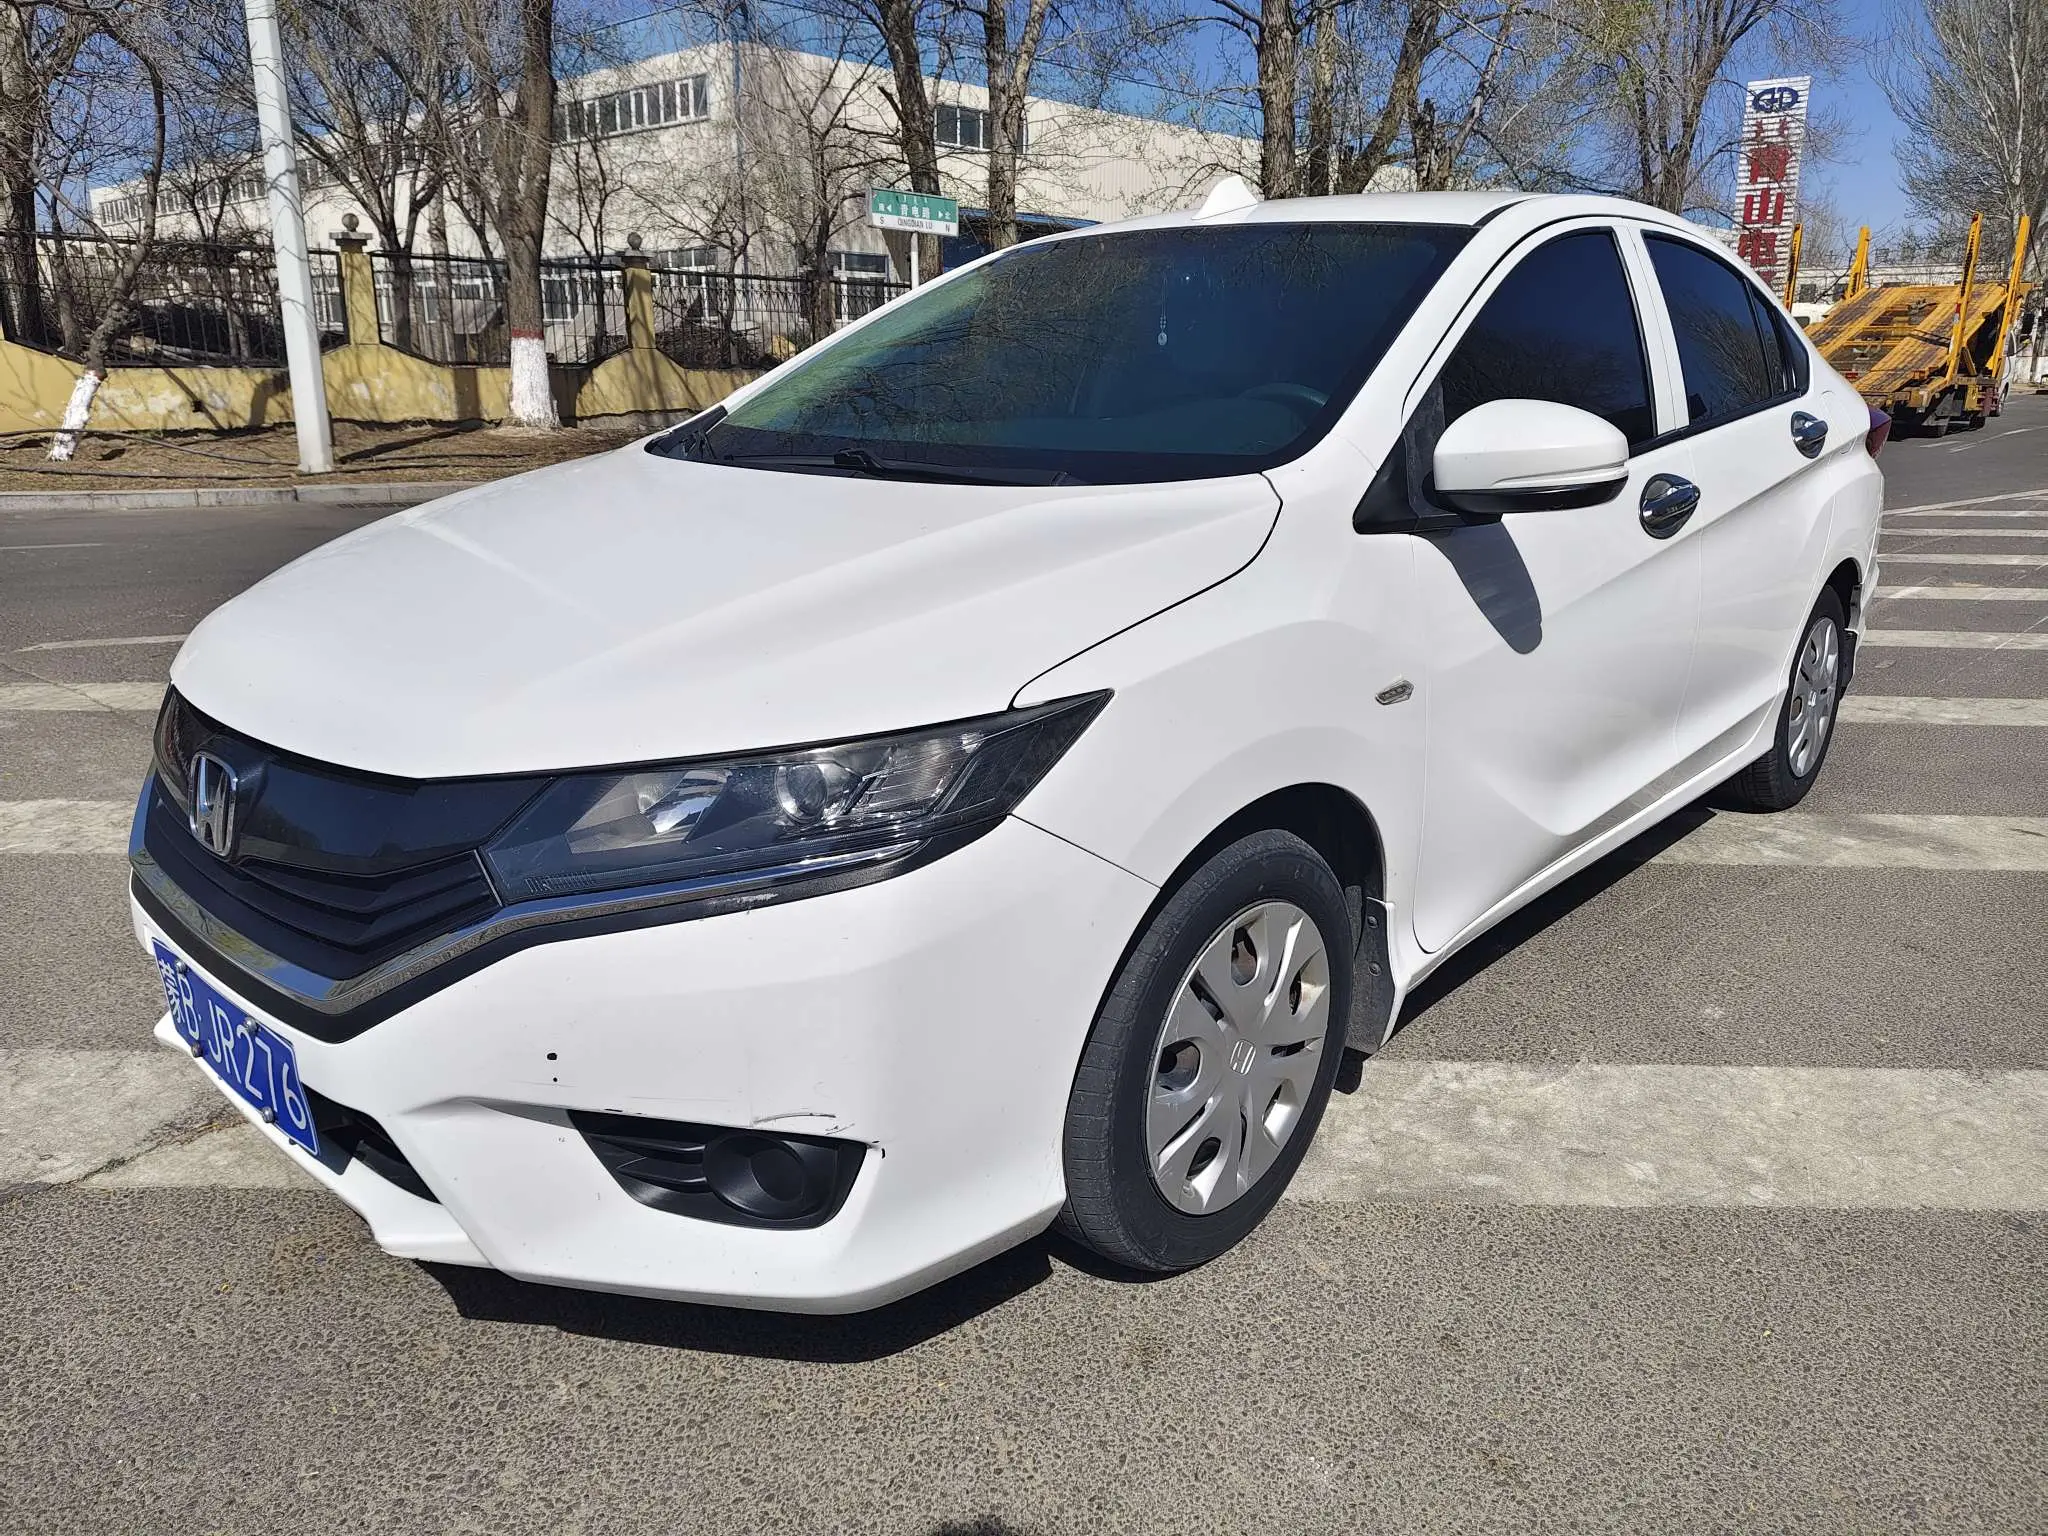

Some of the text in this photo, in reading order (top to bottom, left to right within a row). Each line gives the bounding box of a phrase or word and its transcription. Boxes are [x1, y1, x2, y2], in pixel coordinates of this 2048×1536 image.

[879, 216, 951, 233] S QINGDIAN LU N
